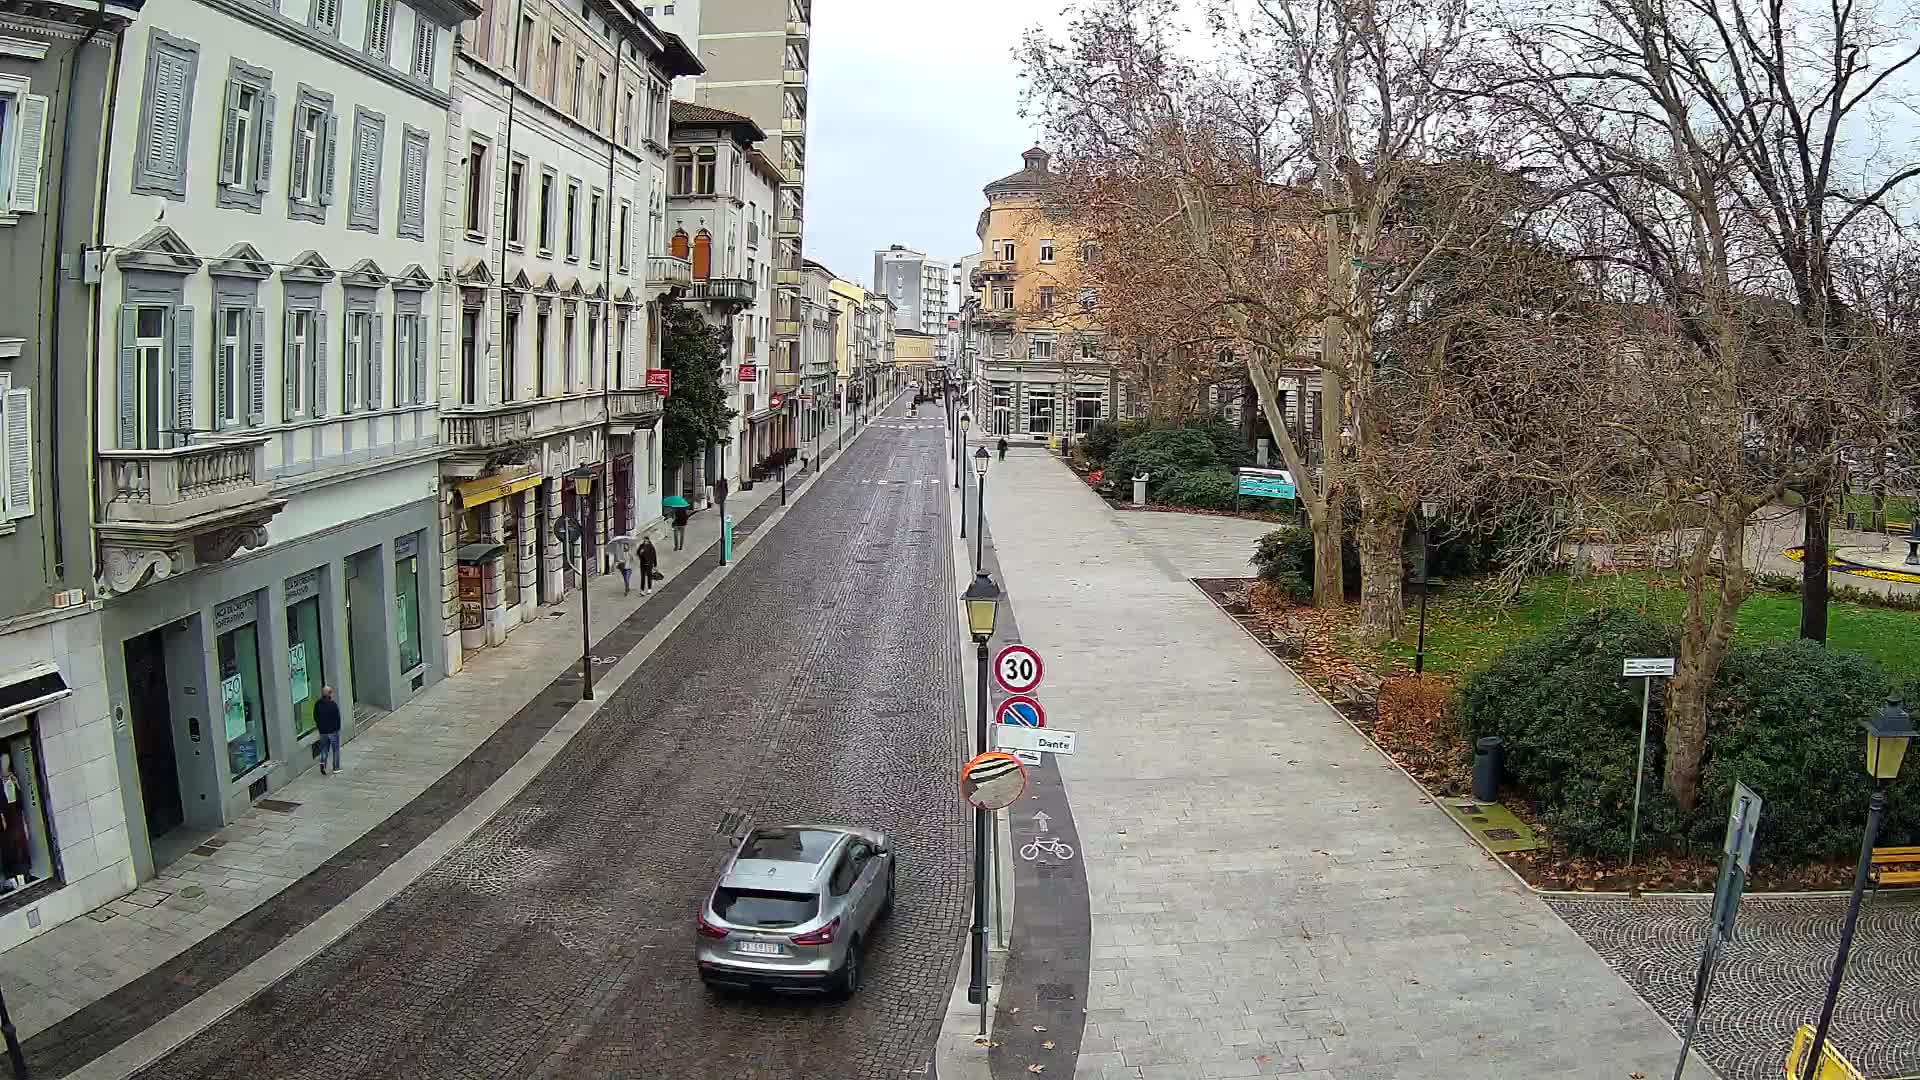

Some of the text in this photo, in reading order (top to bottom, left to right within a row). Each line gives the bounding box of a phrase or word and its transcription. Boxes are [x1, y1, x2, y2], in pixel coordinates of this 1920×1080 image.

[1006, 658, 1033, 681] 30
[223, 677, 241, 701] 130
[1038, 738, 1070, 750] Dante
